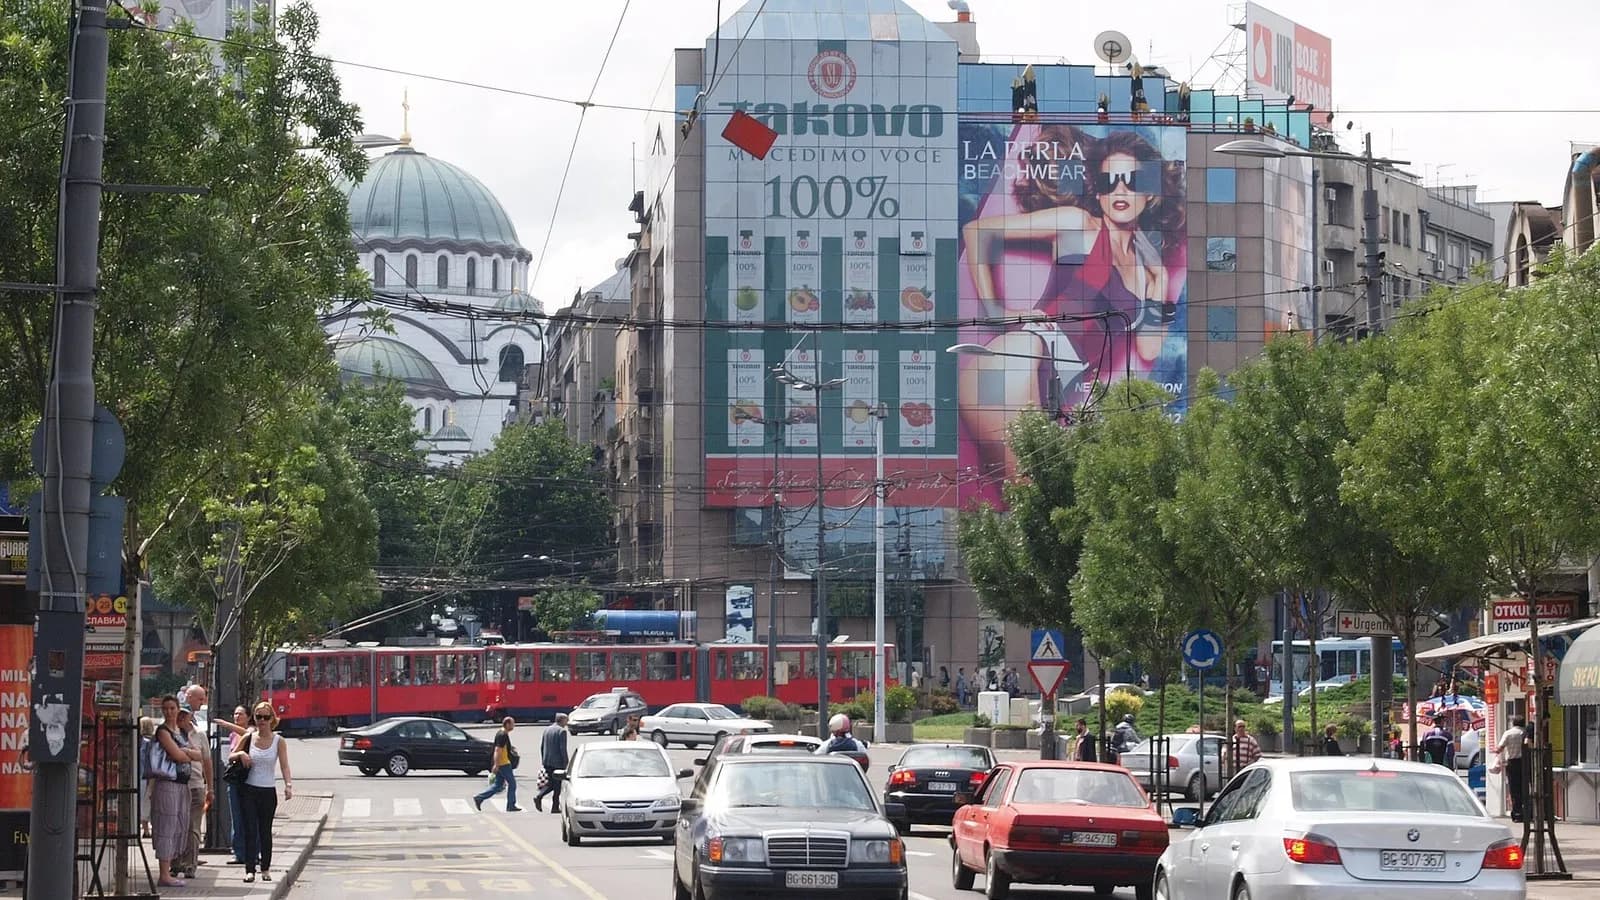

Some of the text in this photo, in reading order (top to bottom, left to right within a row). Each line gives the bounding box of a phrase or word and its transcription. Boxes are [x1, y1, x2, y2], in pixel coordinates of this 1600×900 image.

[770, 148, 866, 162] CEDIMO
[963, 140, 1086, 161] LA PERLA
[964, 163, 1086, 180] BEACHWEAR
[764, 174, 899, 219] 100%
[1536, 604, 1570, 617] ZLATA
